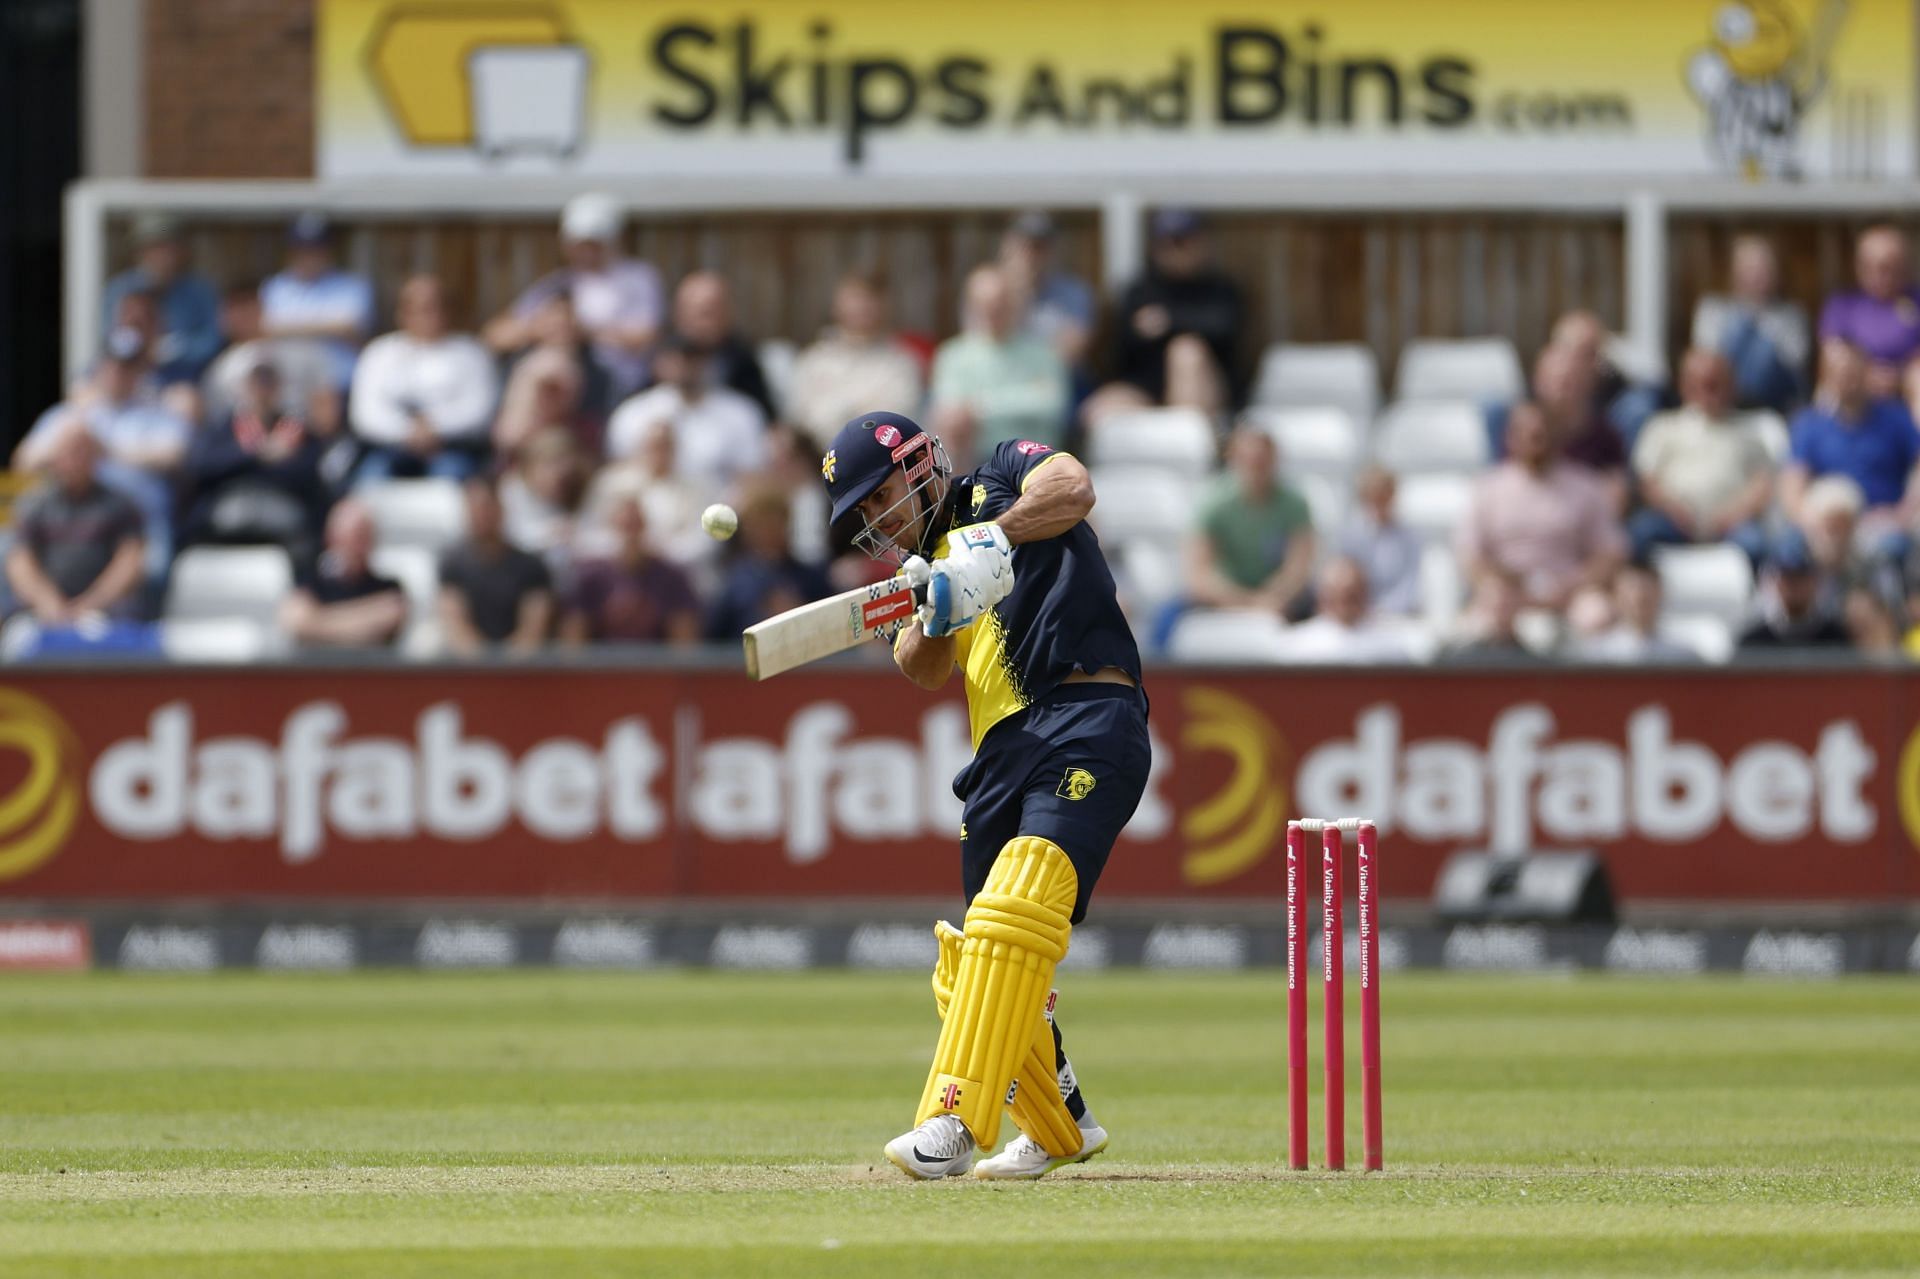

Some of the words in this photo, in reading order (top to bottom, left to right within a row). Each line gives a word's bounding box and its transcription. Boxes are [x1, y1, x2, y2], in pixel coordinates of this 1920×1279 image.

[90, 702, 664, 862] dafabet
[1296, 704, 1877, 852] dafabet
[1288, 866, 1297, 904] Vitality
[1324, 868, 1334, 906] Vitality
[1360, 865, 1369, 902] Vitality
[1288, 905, 1297, 939] Health
[1325, 908, 1334, 928] Life
[1361, 904, 1370, 938] Health
[1288, 941, 1297, 989] insurance
[1325, 930, 1334, 982] insurance
[1362, 939, 1370, 989] insurance
